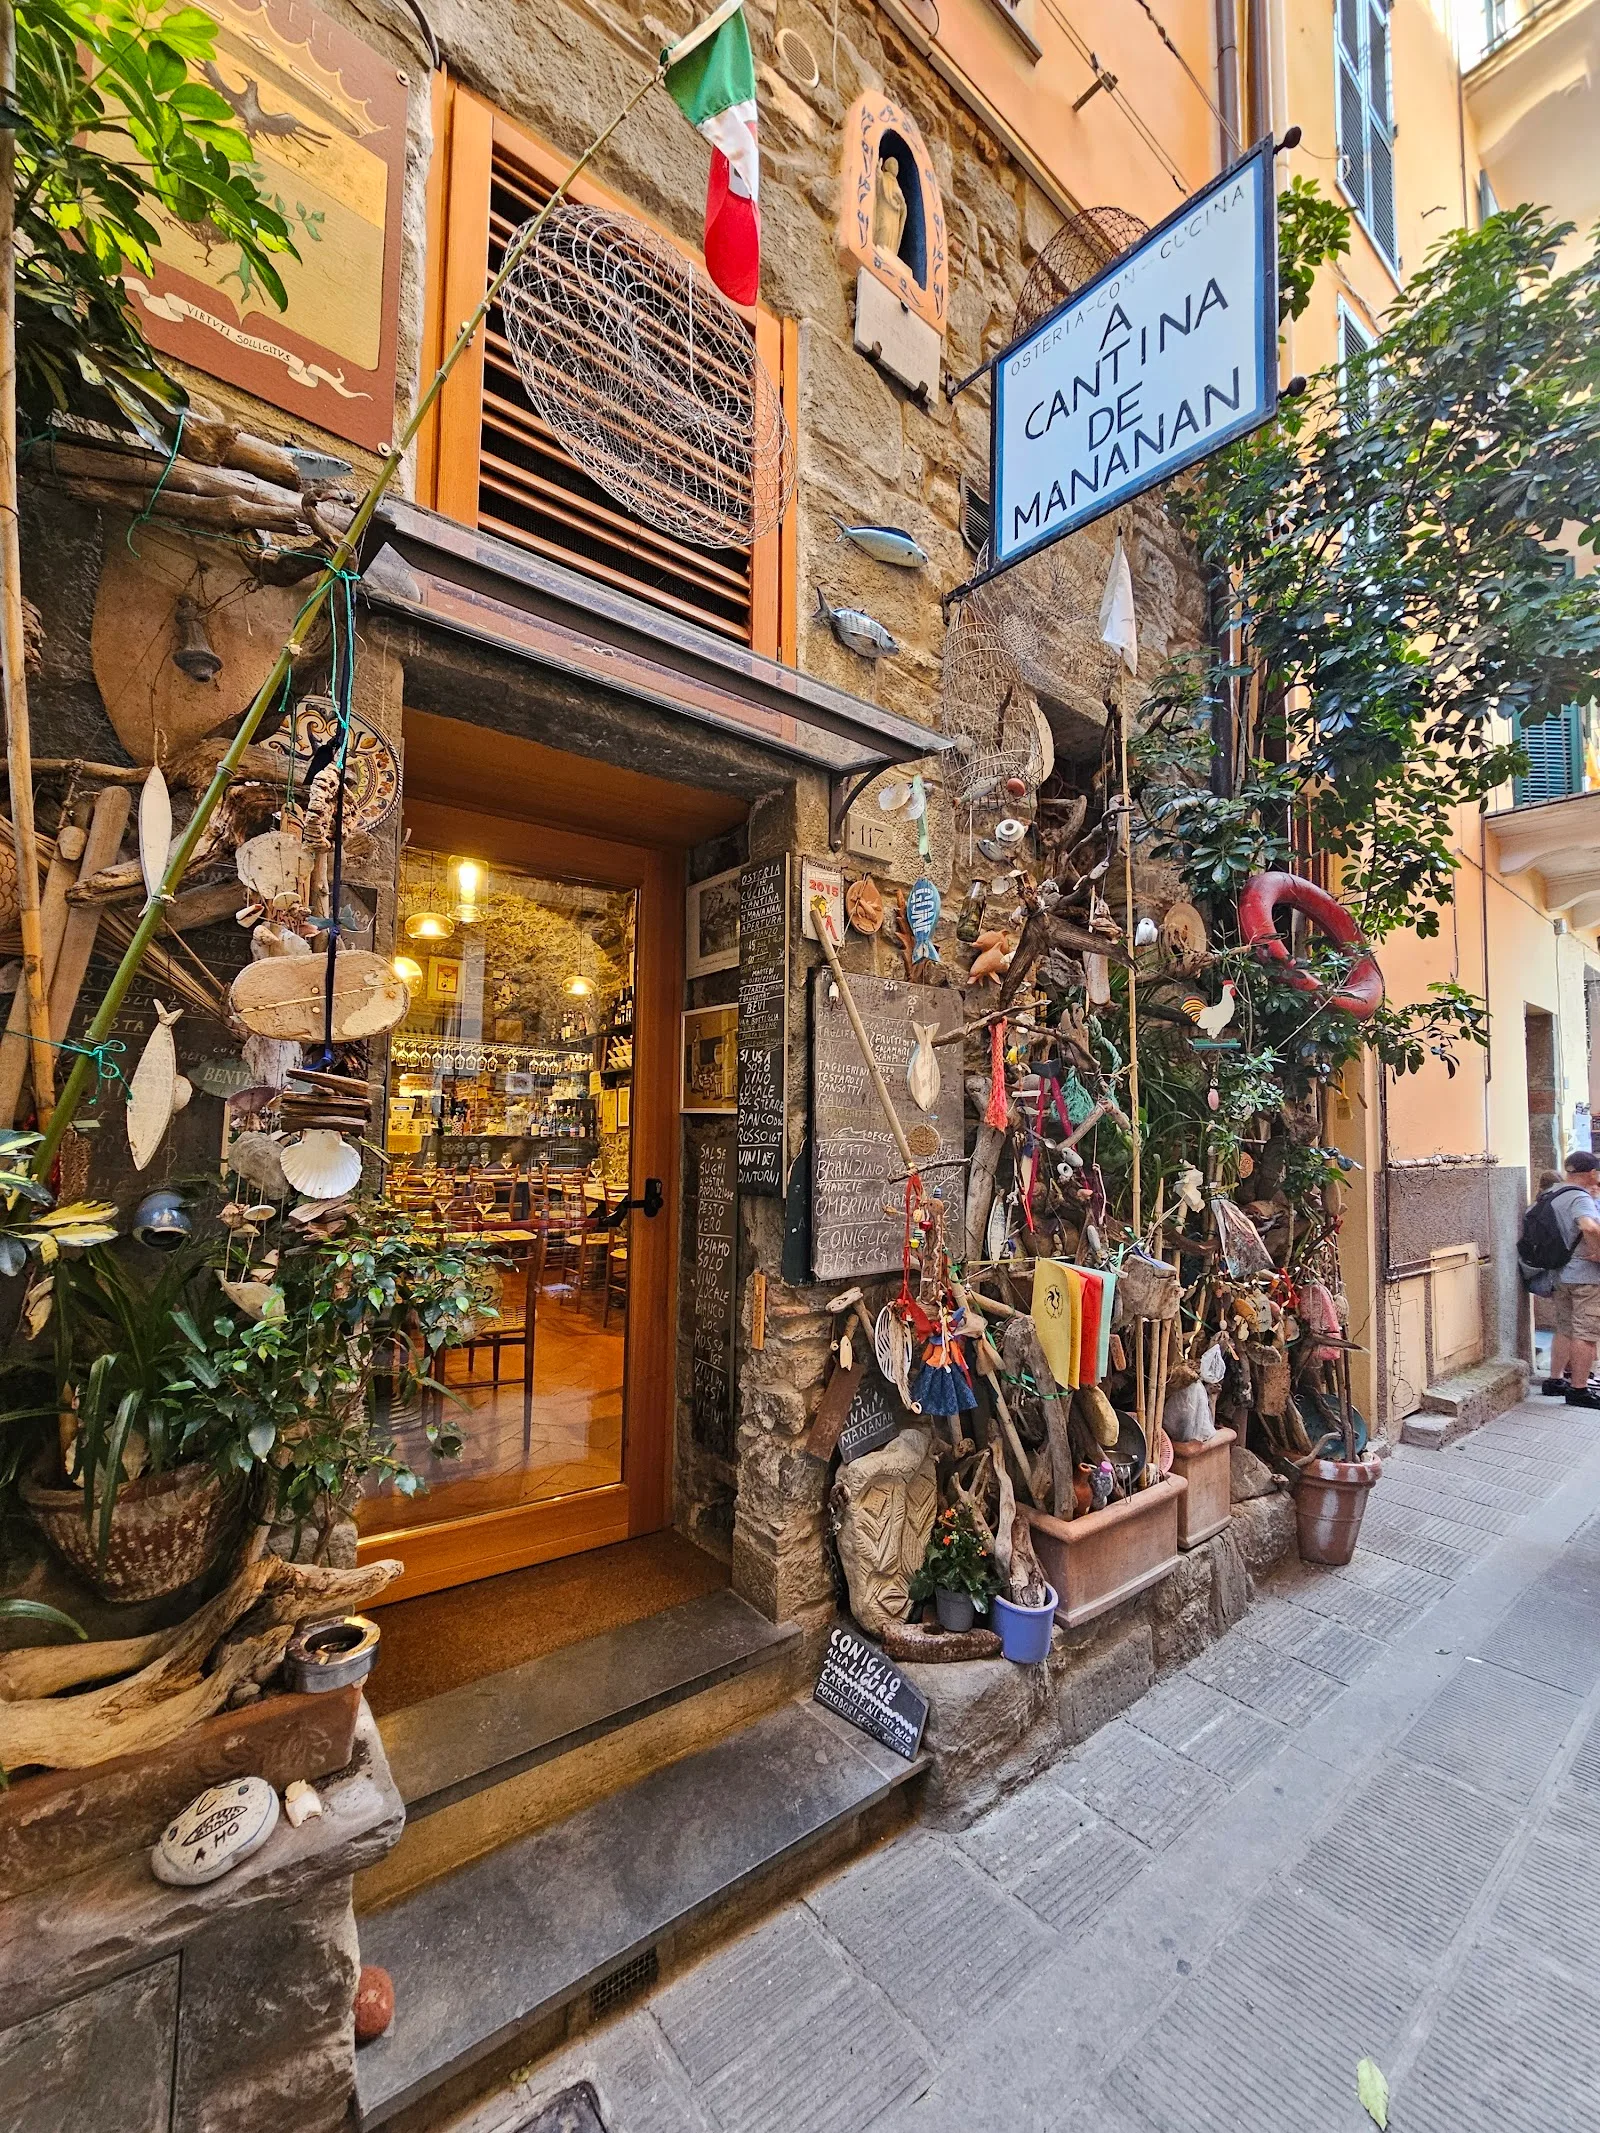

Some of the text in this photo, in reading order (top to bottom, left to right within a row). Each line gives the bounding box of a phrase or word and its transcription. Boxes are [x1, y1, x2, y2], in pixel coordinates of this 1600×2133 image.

[186, 303, 230, 336] VIRTVTI
[1098, 302, 1132, 352] A
[1025, 277, 1229, 440] CANTINA
[1089, 381, 1142, 452] DE
[1014, 366, 1239, 540] MANANAN
[860, 824, 884, 848] 117
[741, 864, 780, 886] OSTERIA
[741, 883, 774, 901] CUCINA
[809, 880, 839, 898] 2015
[744, 893, 779, 909] CANTINA
[747, 904, 781, 921] MANANAN
[741, 915, 782, 932] APERTURA
[754, 927, 778, 938] PRANZO
[746, 1000, 766, 1014] BEVI
[907, 995, 919, 1005] 25
[818, 1011, 849, 1025] PASTA
[875, 1033, 902, 1045] FRUTTI
[740, 1049, 748, 1061] SI
[752, 1049, 771, 1064] USA
[874, 1052, 898, 1062] SCAMPI
[875, 1045, 910, 1057] CALAMARI
[747, 1060, 770, 1073] SOLO
[876, 1065, 895, 1074] ESTO
[203, 1066, 251, 1087] BENVE
[744, 1072, 771, 1085] VINO
[818, 1072, 864, 1086] TESTAROLI
[739, 1083, 776, 1099] LOCALE
[818, 1082, 863, 1096] PANSOTTI
[738, 1109, 773, 1127] BIANCO
[737, 1127, 782, 1144] ROSSO IGT
[700, 1143, 727, 1160] SALSE
[738, 1150, 775, 1167] VINI DEI
[818, 1144, 871, 1159] FILETTO
[700, 1161, 726, 1176] SUGHI
[816, 1160, 884, 1182] BRANZINO
[699, 1176, 724, 1187] NOSTRA
[738, 1169, 780, 1186] DINTORNI
[699, 1186, 734, 1200] PRODUZIONE
[946, 1184, 959, 1200] 23
[698, 1201, 724, 1217] PESTO
[816, 1195, 881, 1217] OMBRINA
[943, 1200, 959, 1221] 23
[698, 1217, 721, 1232] VERO
[817, 1226, 890, 1250] CONIGLIO
[697, 1237, 730, 1257] USIAMO
[698, 1252, 723, 1271] SOLO
[822, 1247, 888, 1276] BISTECCA
[697, 1269, 717, 1287] VINO
[698, 1286, 729, 1305] LOCALE
[695, 1297, 725, 1319] BIANCO
[694, 1328, 724, 1351] ROSSO
[709, 1350, 723, 1365] IGT
[841, 1411, 893, 1447] MANANAN
[830, 1628, 901, 1692] CONIGLIO
[827, 1647, 897, 1706] ALLA LIGURE
[821, 1668, 879, 1717] CARCIOFINI
[817, 1682, 858, 1716] POMODORI
[857, 1714, 880, 1737] SECCHI
